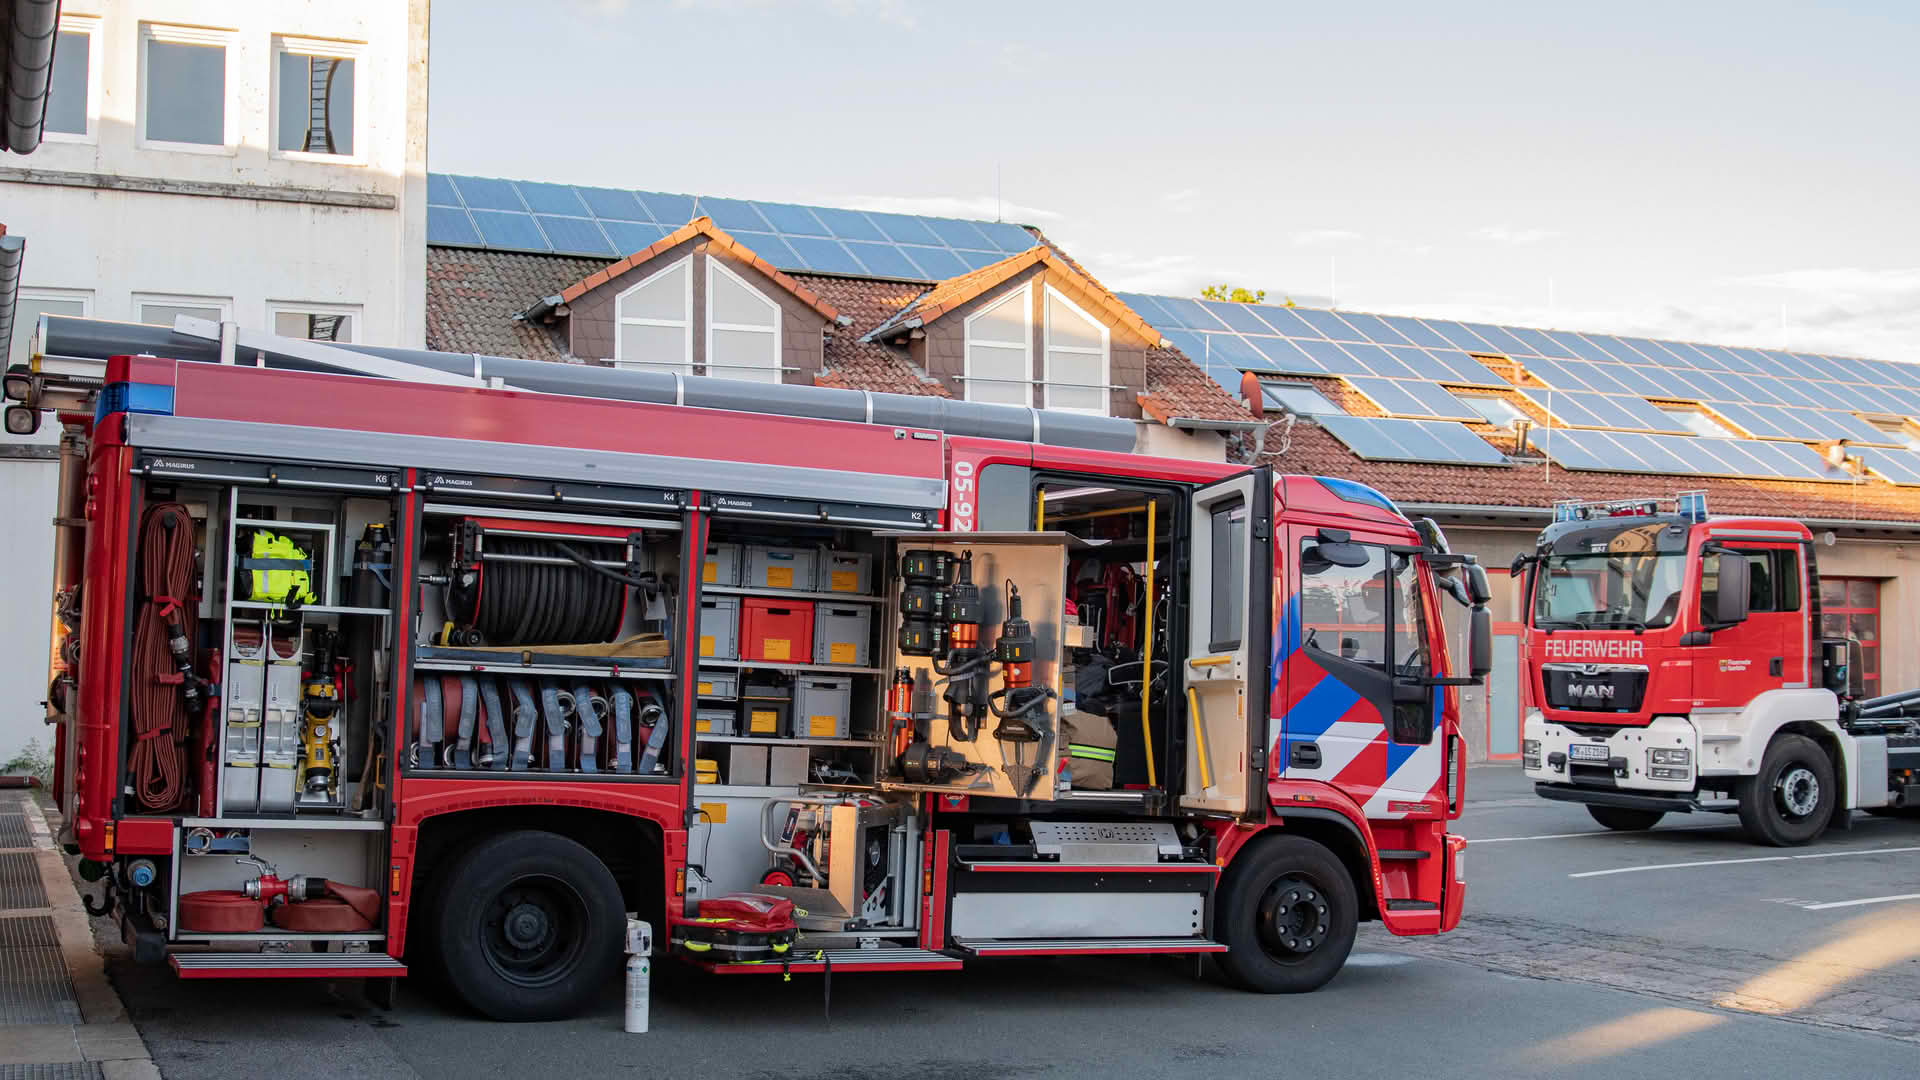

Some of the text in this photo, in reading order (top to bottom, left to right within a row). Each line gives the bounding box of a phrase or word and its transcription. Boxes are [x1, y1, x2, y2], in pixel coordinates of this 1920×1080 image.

[375, 474, 388, 483] K6
[663, 492, 674, 501] K4
[911, 511, 922, 520] K2
[1545, 639, 1643, 658] FEUERWEHR
[1568, 684, 1615, 698] MAN
